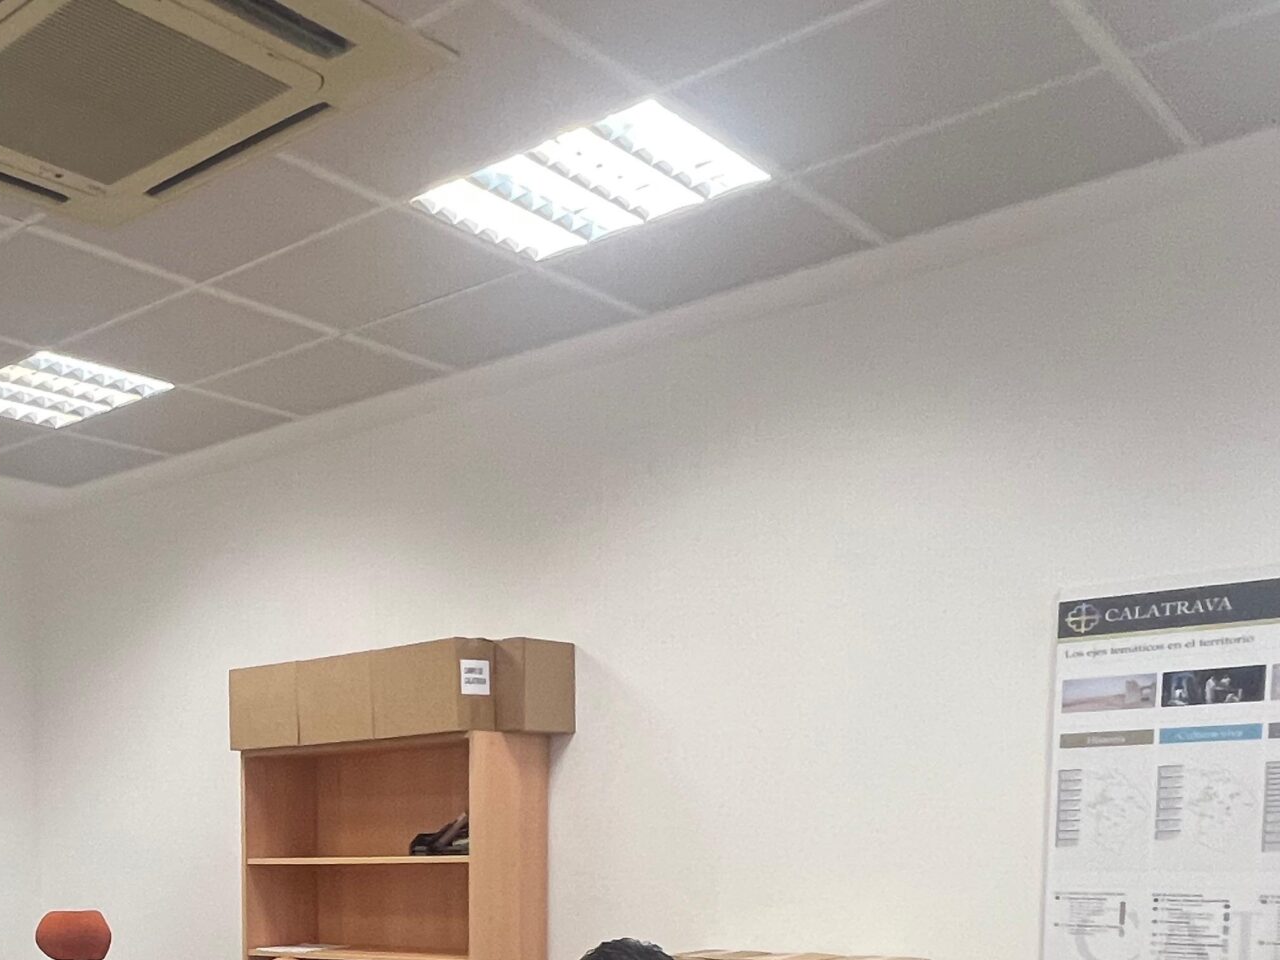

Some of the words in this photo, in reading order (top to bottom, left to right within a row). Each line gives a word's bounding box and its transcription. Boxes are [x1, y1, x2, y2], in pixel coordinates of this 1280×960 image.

[1105, 596, 1233, 622] CALATRAVA
[1065, 650, 1085, 659] Los
[1167, 642, 1182, 650] en
[1184, 639, 1195, 648] el
[1199, 635, 1255, 647] territorio
